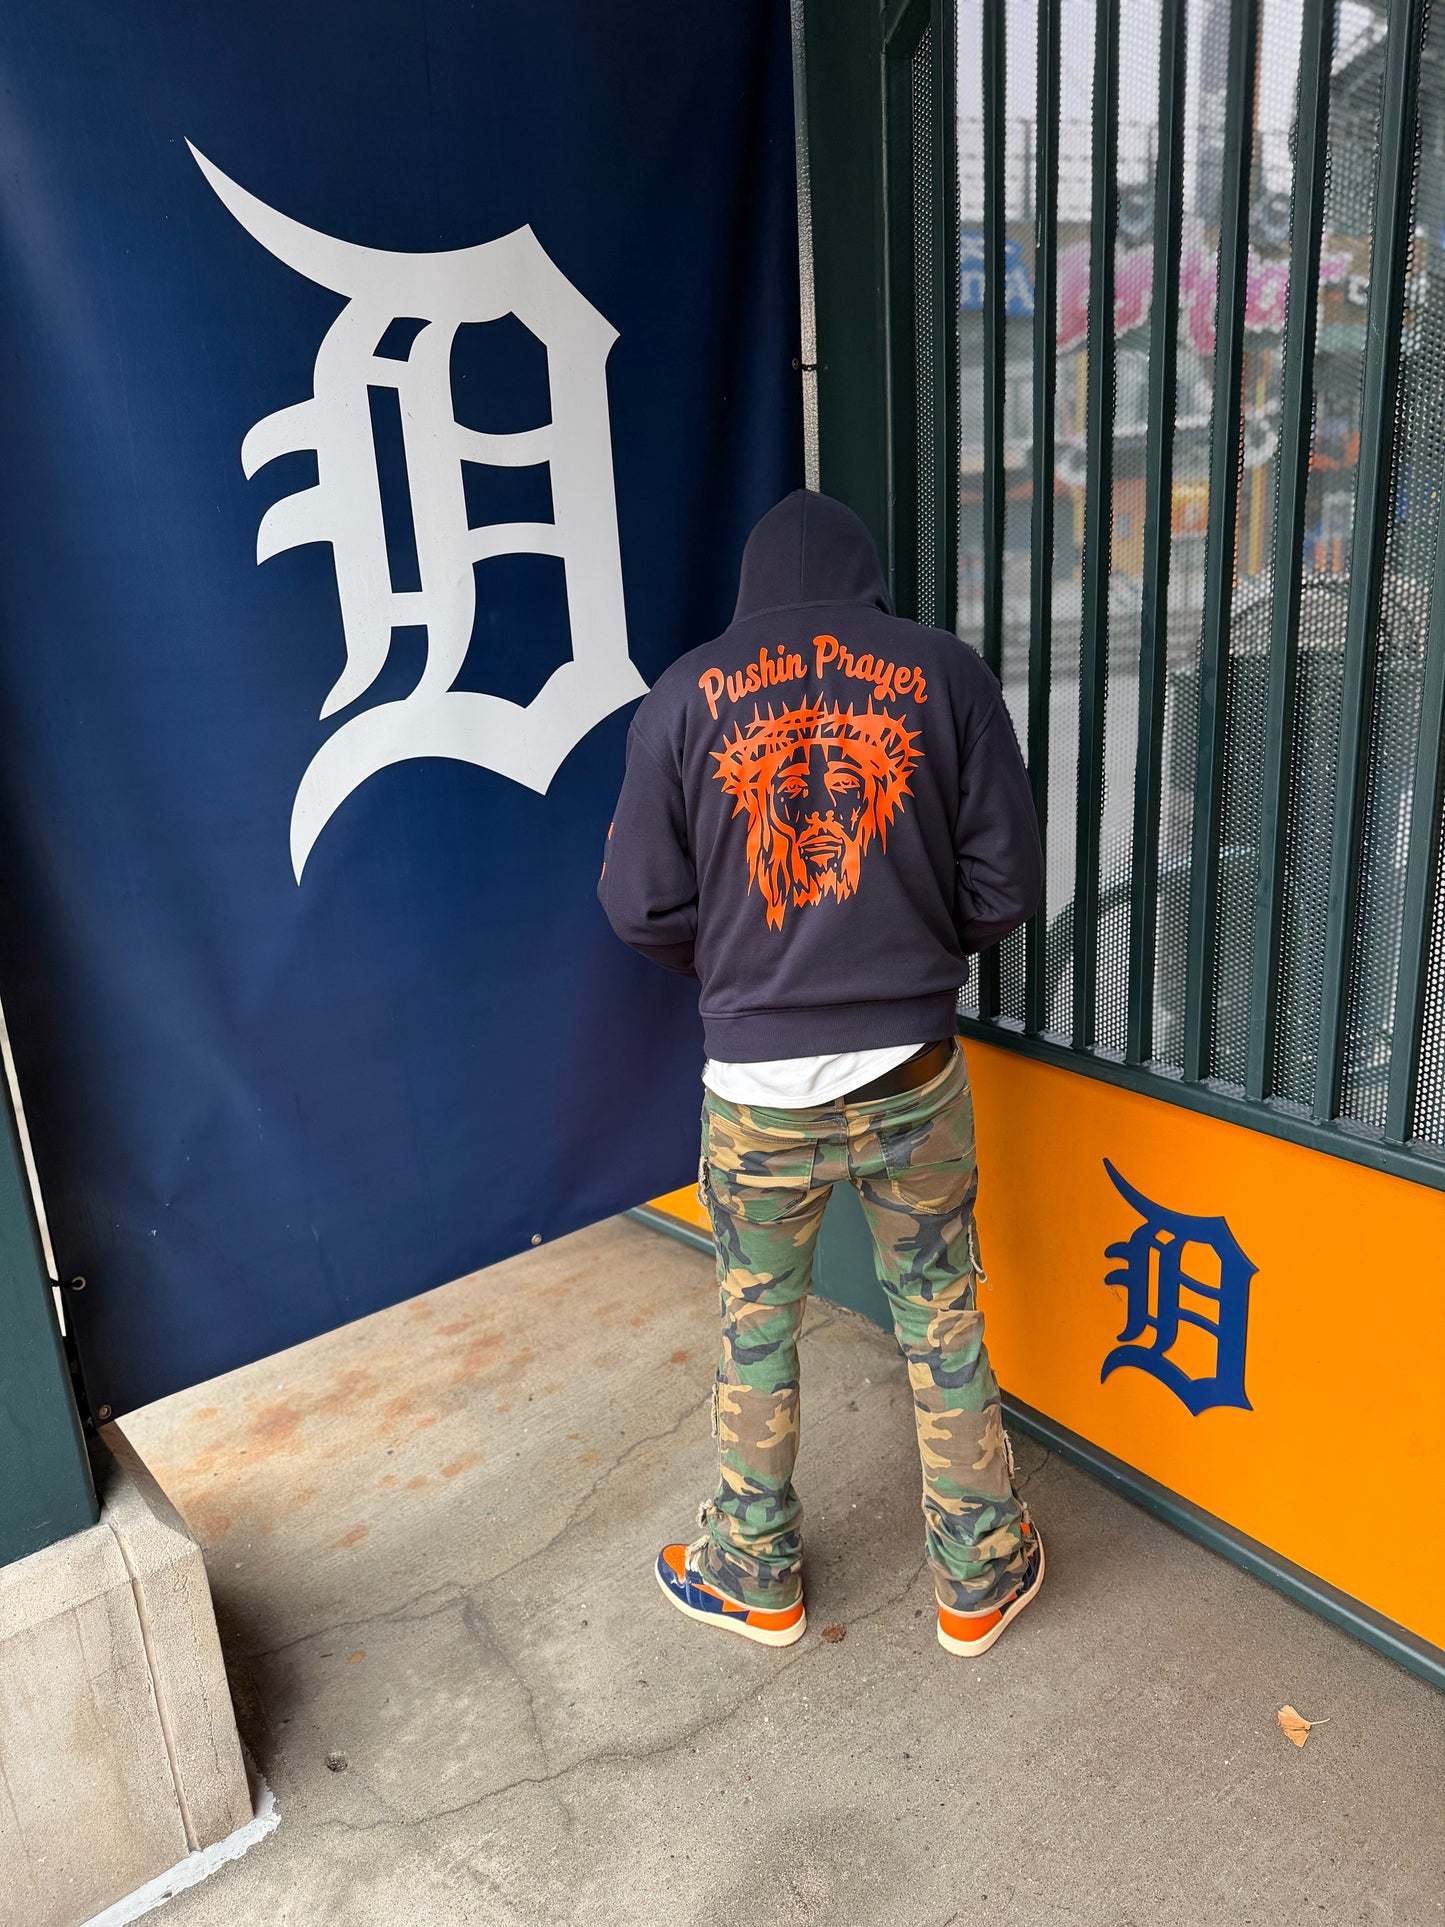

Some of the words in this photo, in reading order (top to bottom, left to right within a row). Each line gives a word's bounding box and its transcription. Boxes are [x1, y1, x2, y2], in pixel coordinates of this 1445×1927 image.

[185, 137, 651, 885] D
[698, 644, 807, 720] Pushin
[812, 634, 928, 704] Prayer
[1100, 1157, 1260, 1417] D
